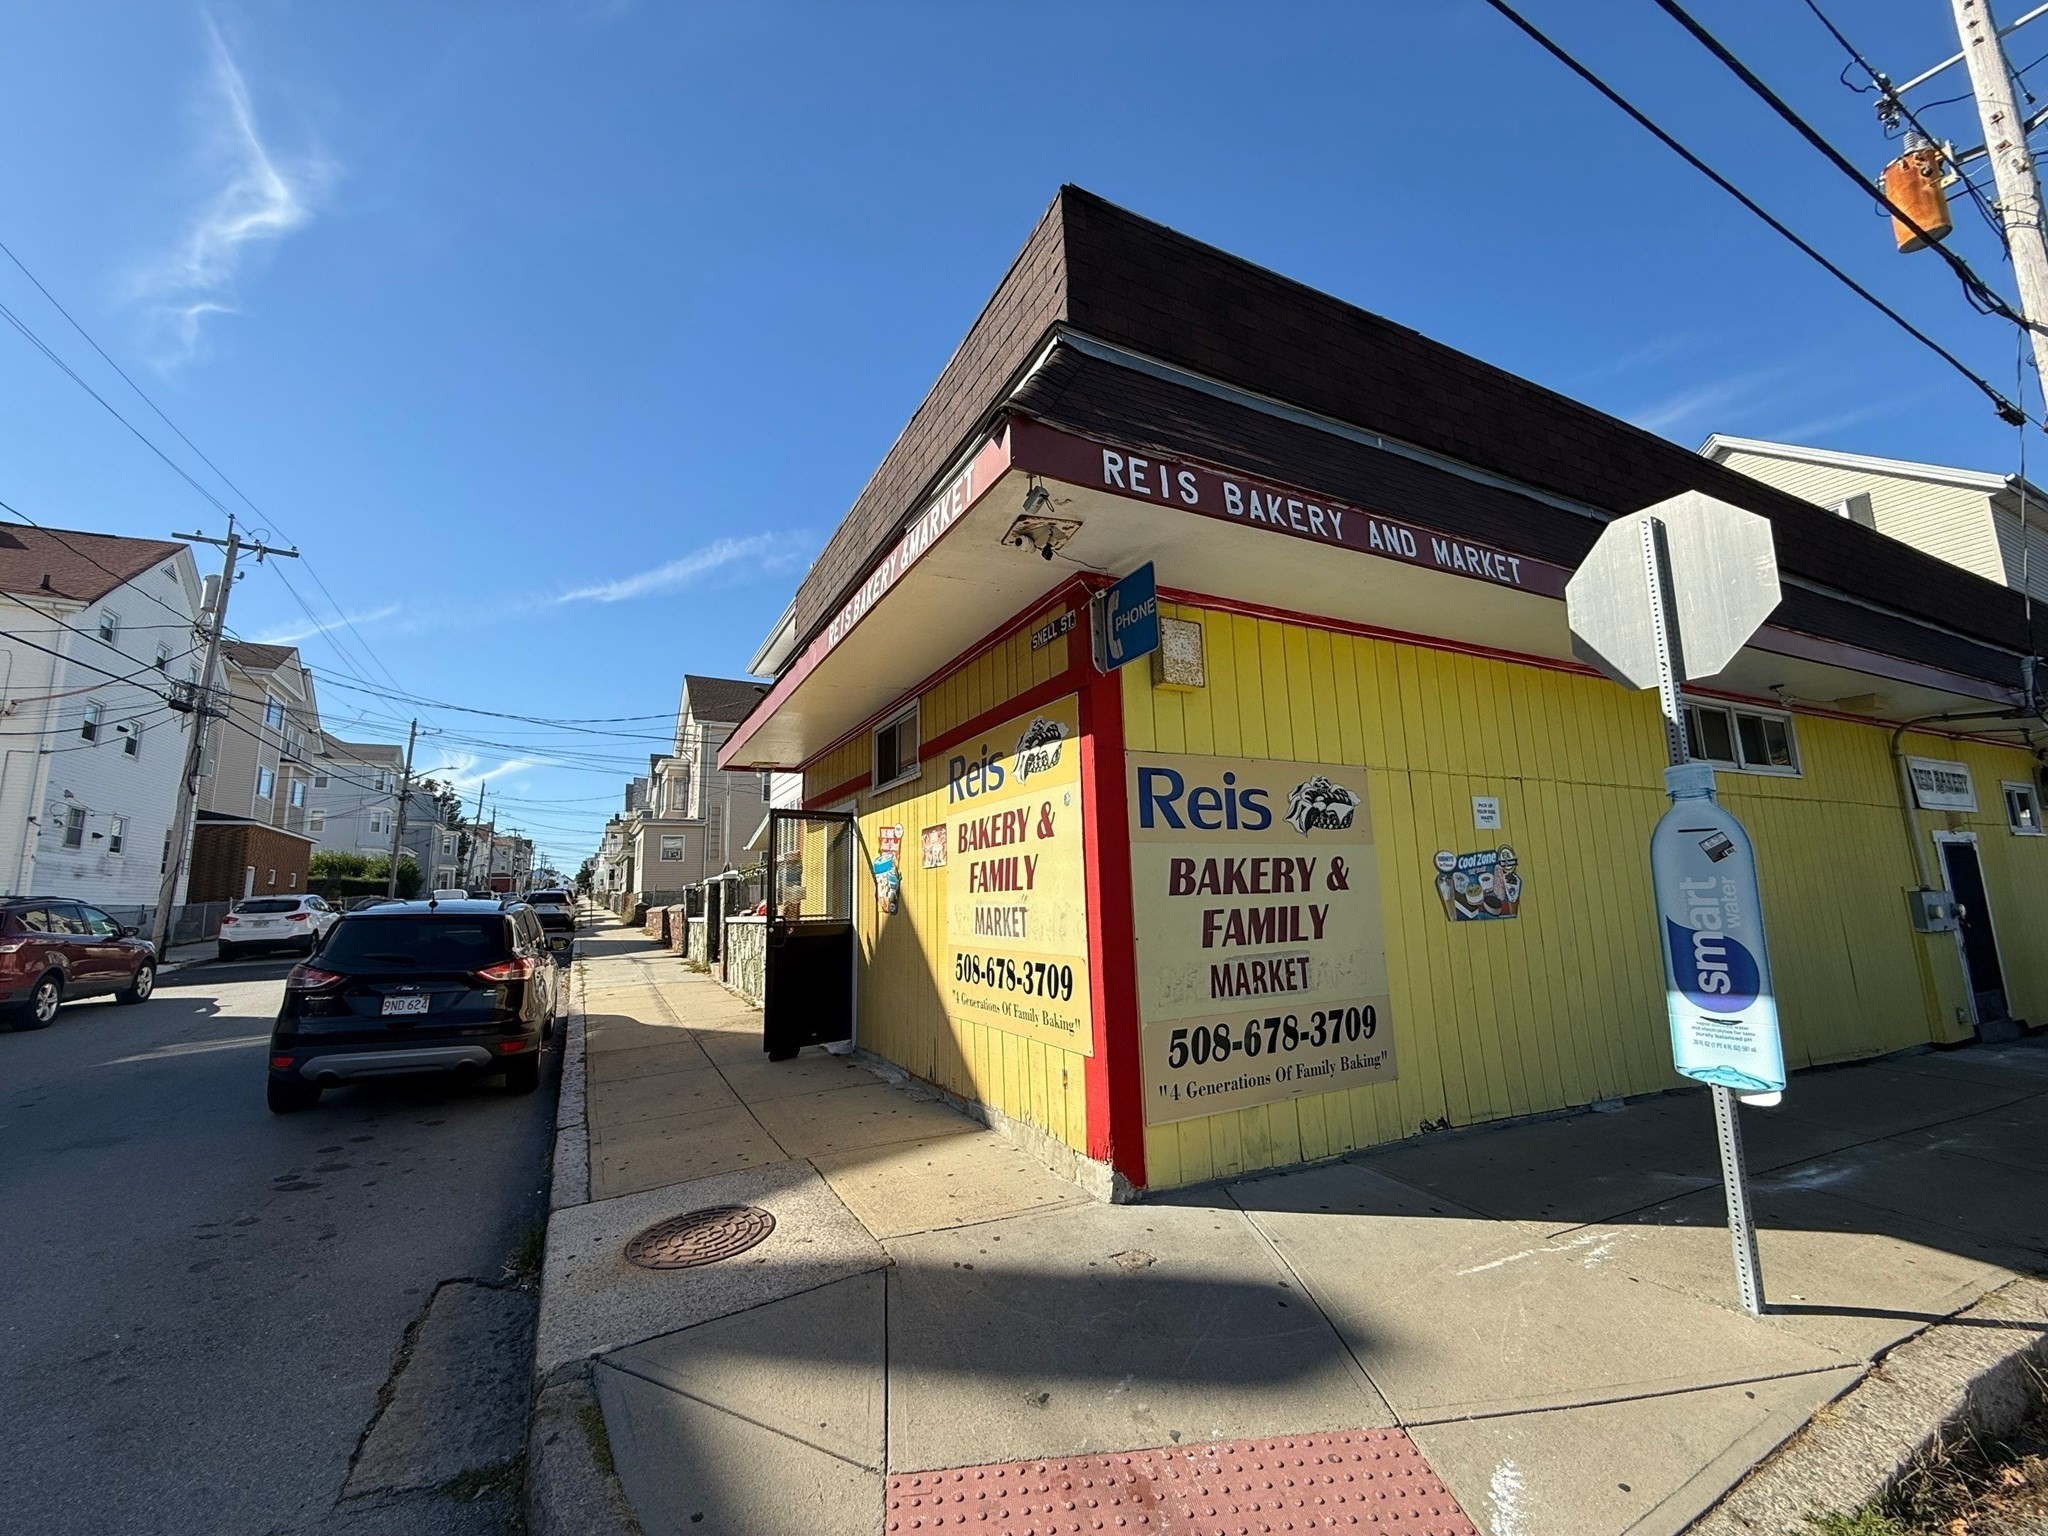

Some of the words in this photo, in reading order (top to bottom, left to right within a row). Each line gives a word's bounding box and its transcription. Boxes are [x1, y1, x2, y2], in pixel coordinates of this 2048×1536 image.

[1102, 449, 1199, 505] REIS
[1223, 481, 1343, 541] BAKERY
[1369, 520, 1417, 558] AND
[1431, 537, 1521, 584] MARKET
[827, 606, 852, 650] REIS
[853, 551, 898, 622] BAKERY
[1115, 596, 1156, 632] PHONE
[1032, 623, 1060, 650] SNELL
[949, 743, 1005, 805] Reis
[1136, 766, 1273, 831] Reis
[957, 805, 1031, 854] BAKERY
[1036, 801, 1056, 840] &
[969, 853, 1039, 894] FAMILY
[1168, 856, 1317, 896] BAKERY
[1326, 855, 1350, 891] &
[1458, 855, 1476, 870] Cool
[1477, 852, 1497, 866] Zone
[974, 906, 1029, 938] MARKET
[1720, 875, 1742, 929] water
[1202, 903, 1330, 949] FAMILY
[1680, 876, 1731, 995] smart
[955, 953, 1073, 1002] 508-678-3709
[1210, 956, 1310, 999] MARKET
[383, 999, 405, 1012] 9ND
[407, 999, 427, 1011] 624
[961, 992, 1000, 1014] Generations
[1002, 1001, 1012, 1017] Of
[1013, 1003, 1040, 1028] Family
[1042, 1010, 1081, 1037] Baking"
[1168, 1004, 1378, 1069] 508-678-3709
[1714, 1033, 1743, 1041] balanced
[1158, 1082, 1181, 1101] "4
[1186, 1073, 1271, 1099] Generations
[1275, 1064, 1294, 1083] Of
[1296, 1059, 1337, 1080] Family
[1340, 1050, 1388, 1072] Baking"
